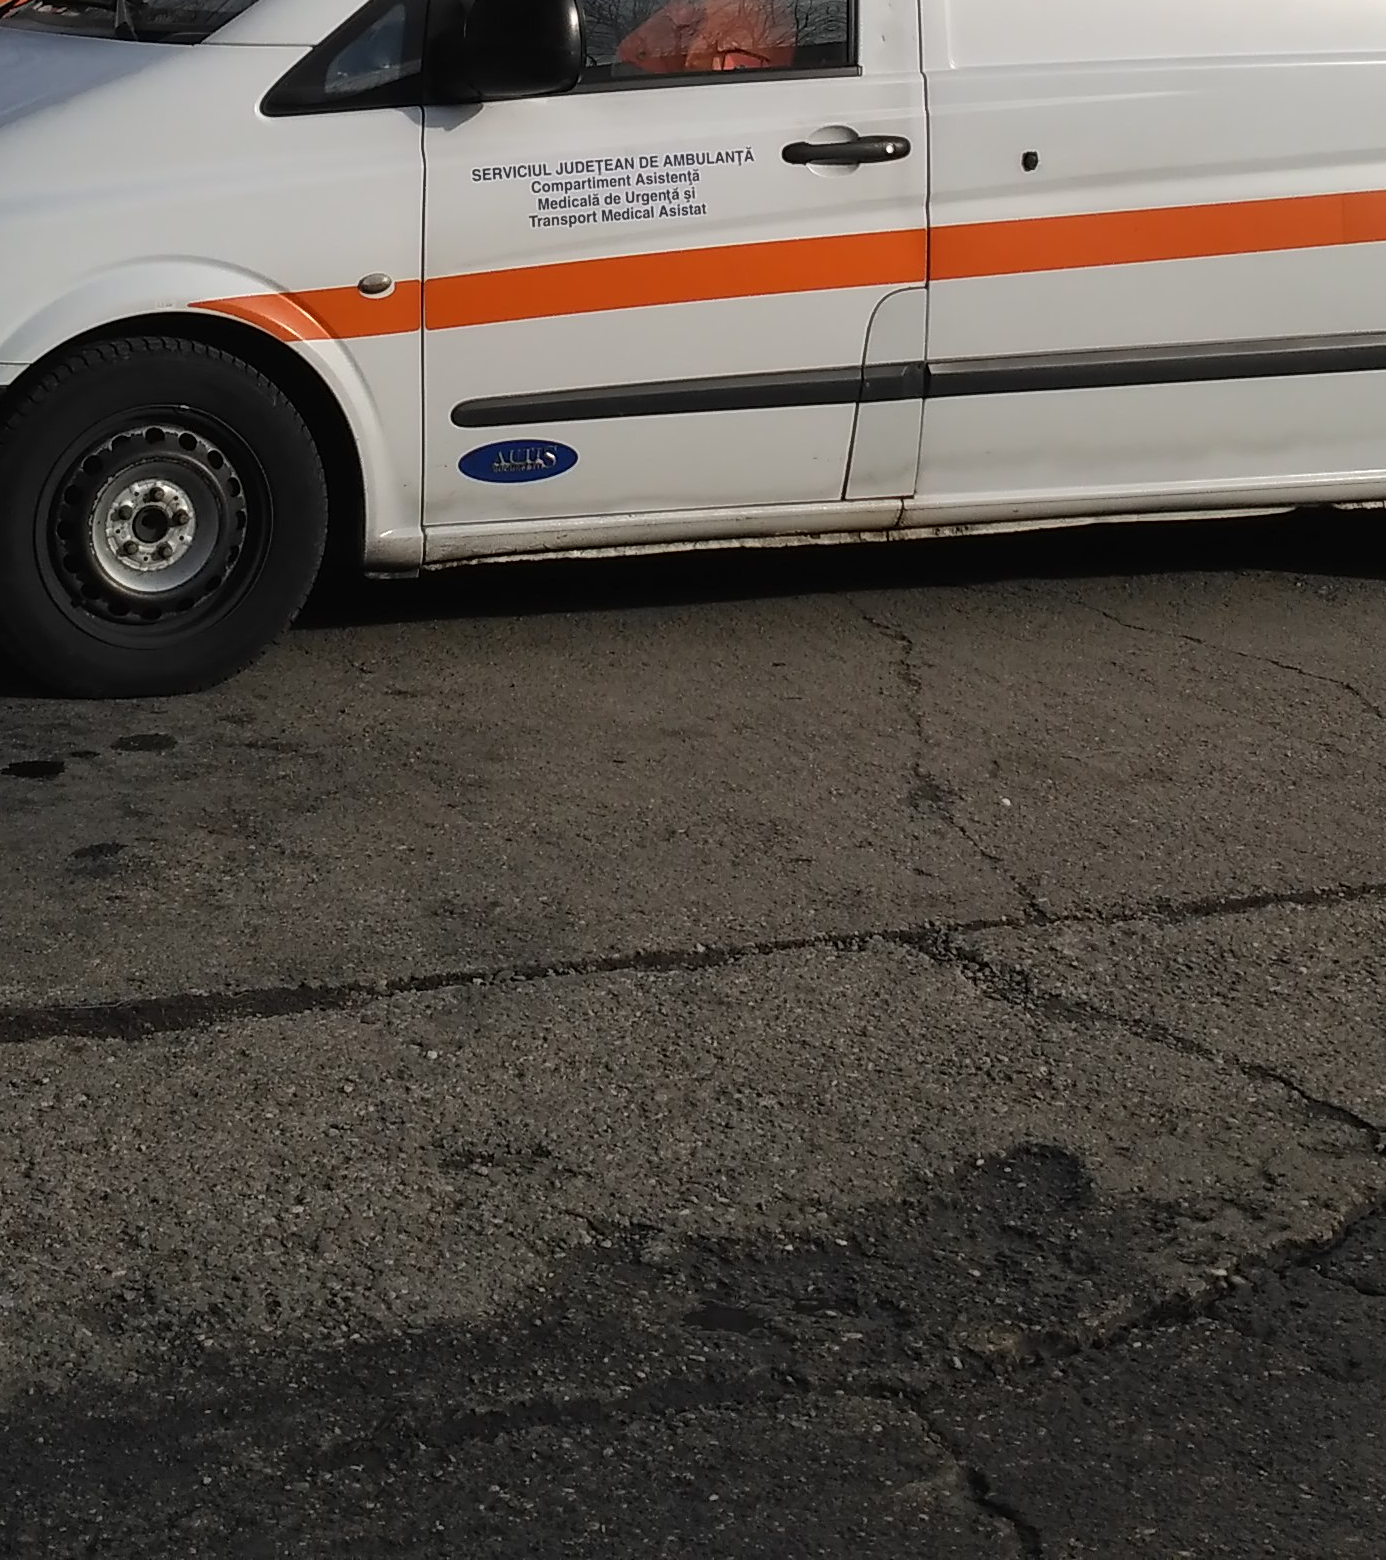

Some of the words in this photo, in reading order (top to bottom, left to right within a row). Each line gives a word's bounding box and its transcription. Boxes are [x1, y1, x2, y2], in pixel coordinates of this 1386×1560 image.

[472, 163, 552, 182] SERVICIUL
[639, 155, 659, 169] DE
[531, 175, 631, 194] Compartiment
[537, 192, 600, 211] Medicală
[604, 191, 621, 206] de
[529, 211, 598, 228] Transport
[601, 206, 655, 222] Medical
[658, 202, 707, 218] Asistat
